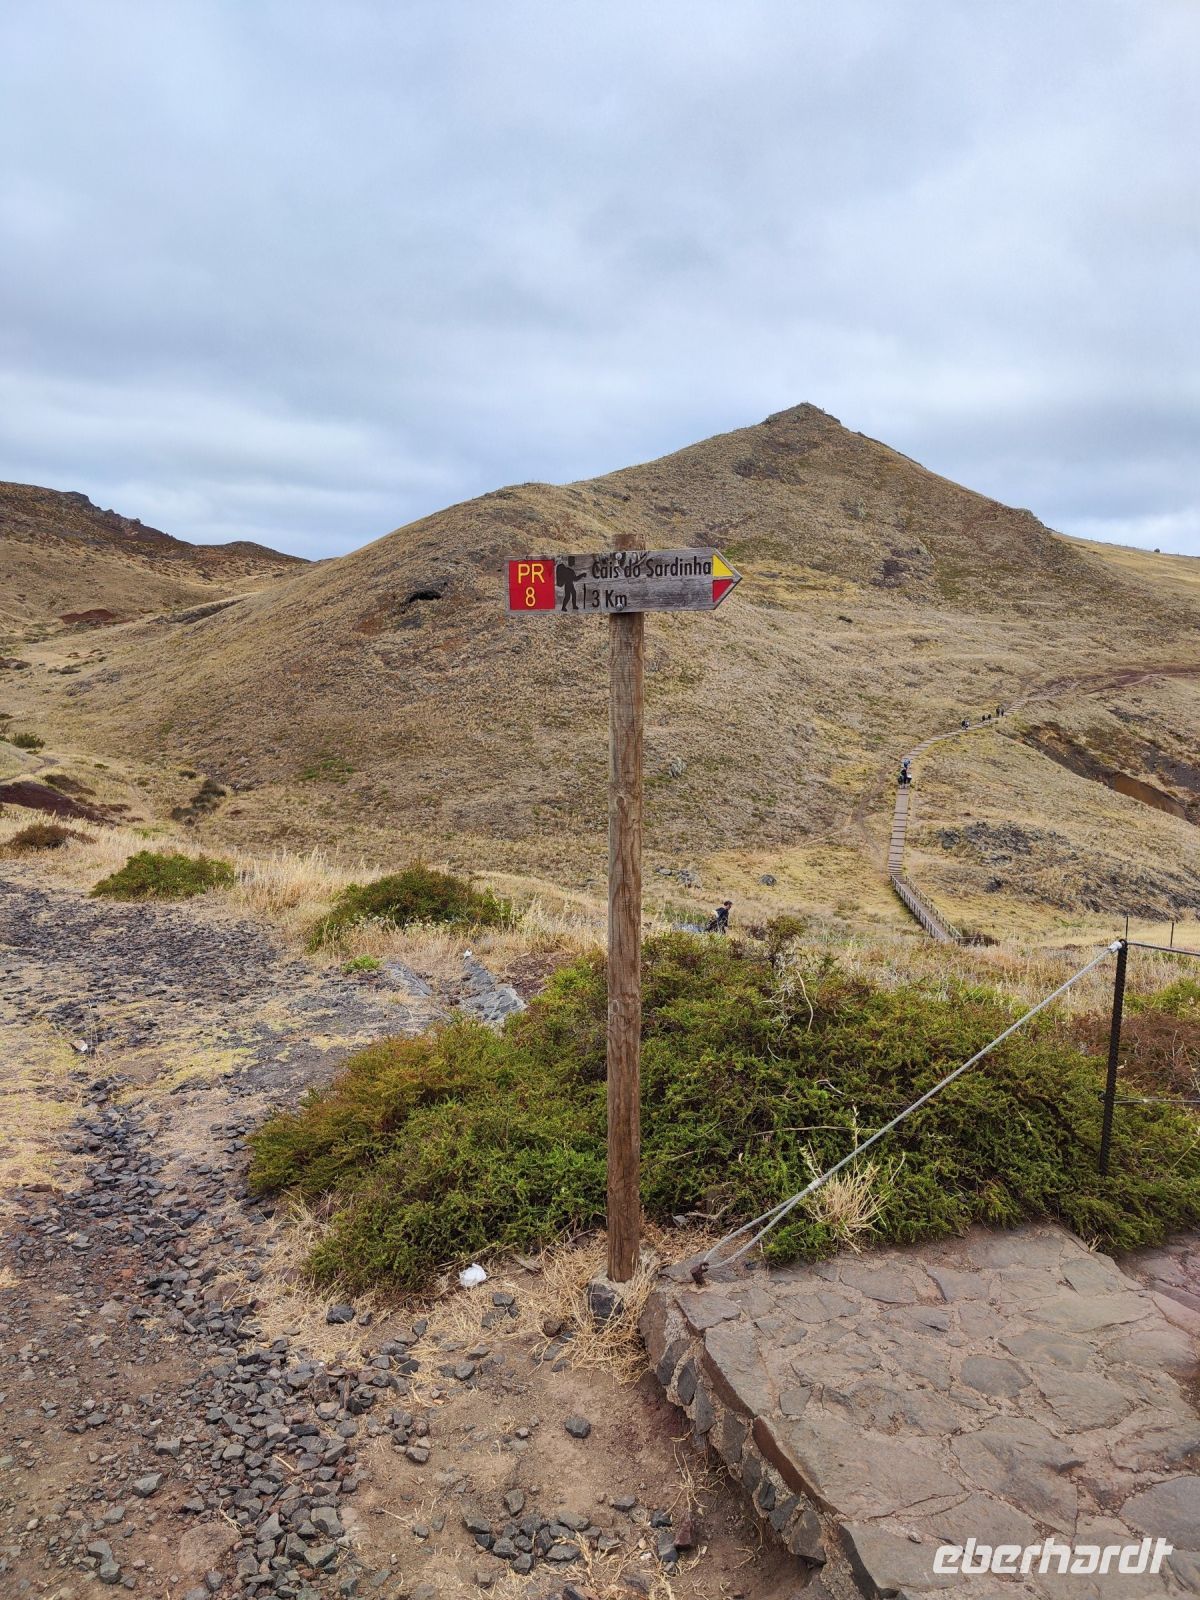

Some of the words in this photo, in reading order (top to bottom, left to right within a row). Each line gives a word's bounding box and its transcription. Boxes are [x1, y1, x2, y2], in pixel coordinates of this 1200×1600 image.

[517, 563, 545, 584] PR
[592, 560, 619, 579] Cais
[624, 559, 641, 578] do
[646, 556, 711, 578] Sardinha
[525, 586, 536, 607] 8
[592, 589, 600, 608] 3
[605, 589, 627, 608] Km
